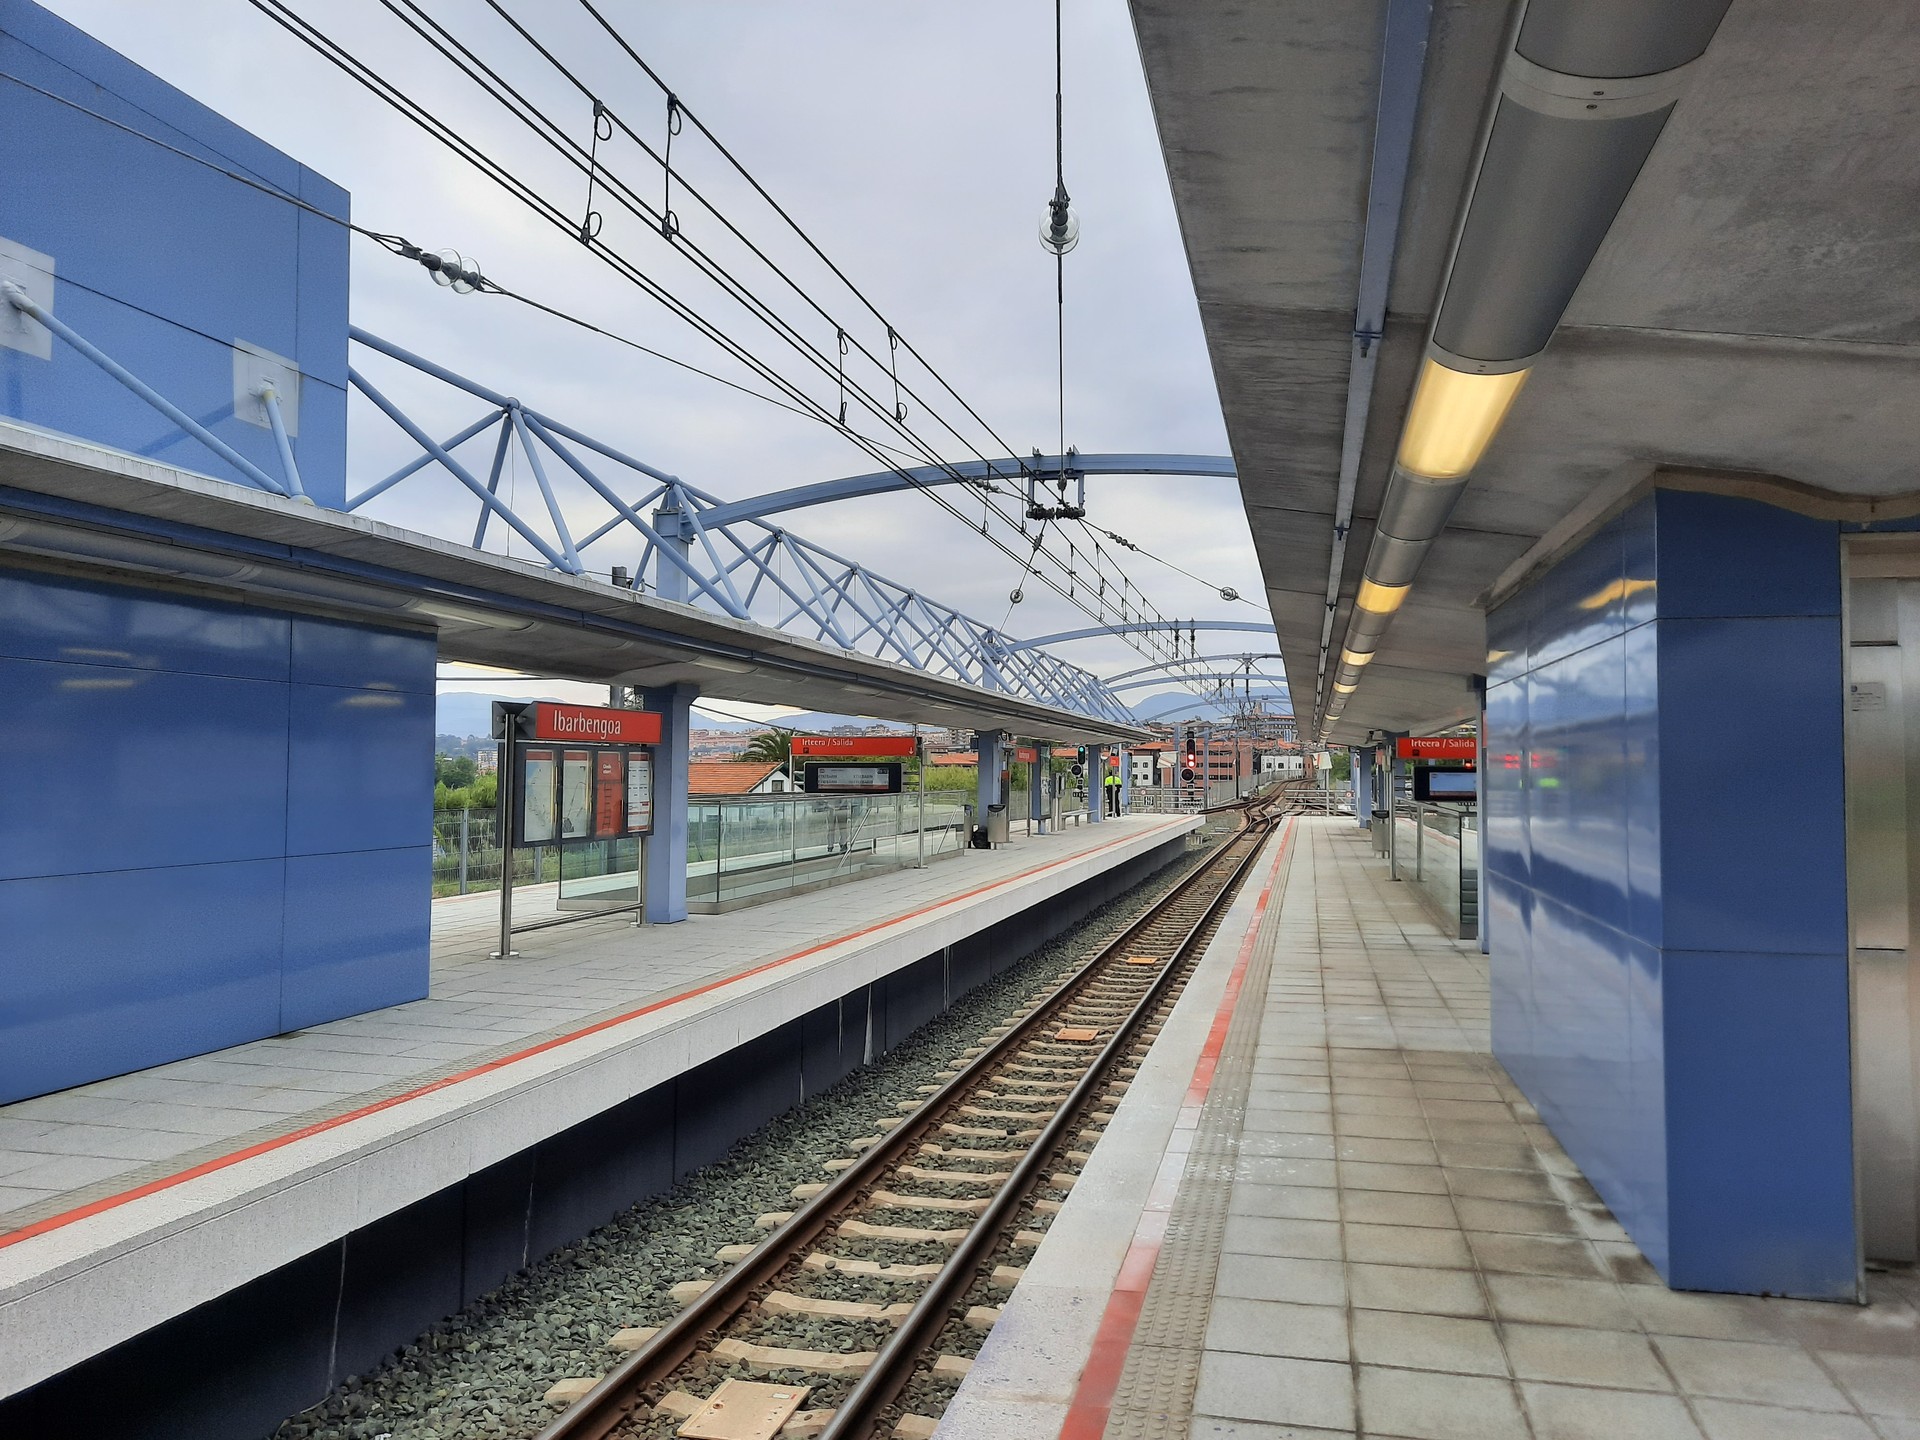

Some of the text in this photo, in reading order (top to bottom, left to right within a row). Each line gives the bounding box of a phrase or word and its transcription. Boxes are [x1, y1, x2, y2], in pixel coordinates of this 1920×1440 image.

[553, 710, 621, 739] Ibarbengoa
[802, 738, 826, 746] Irteera
[1411, 739, 1440, 748] Irteera
[1449, 739, 1475, 748] Salida
